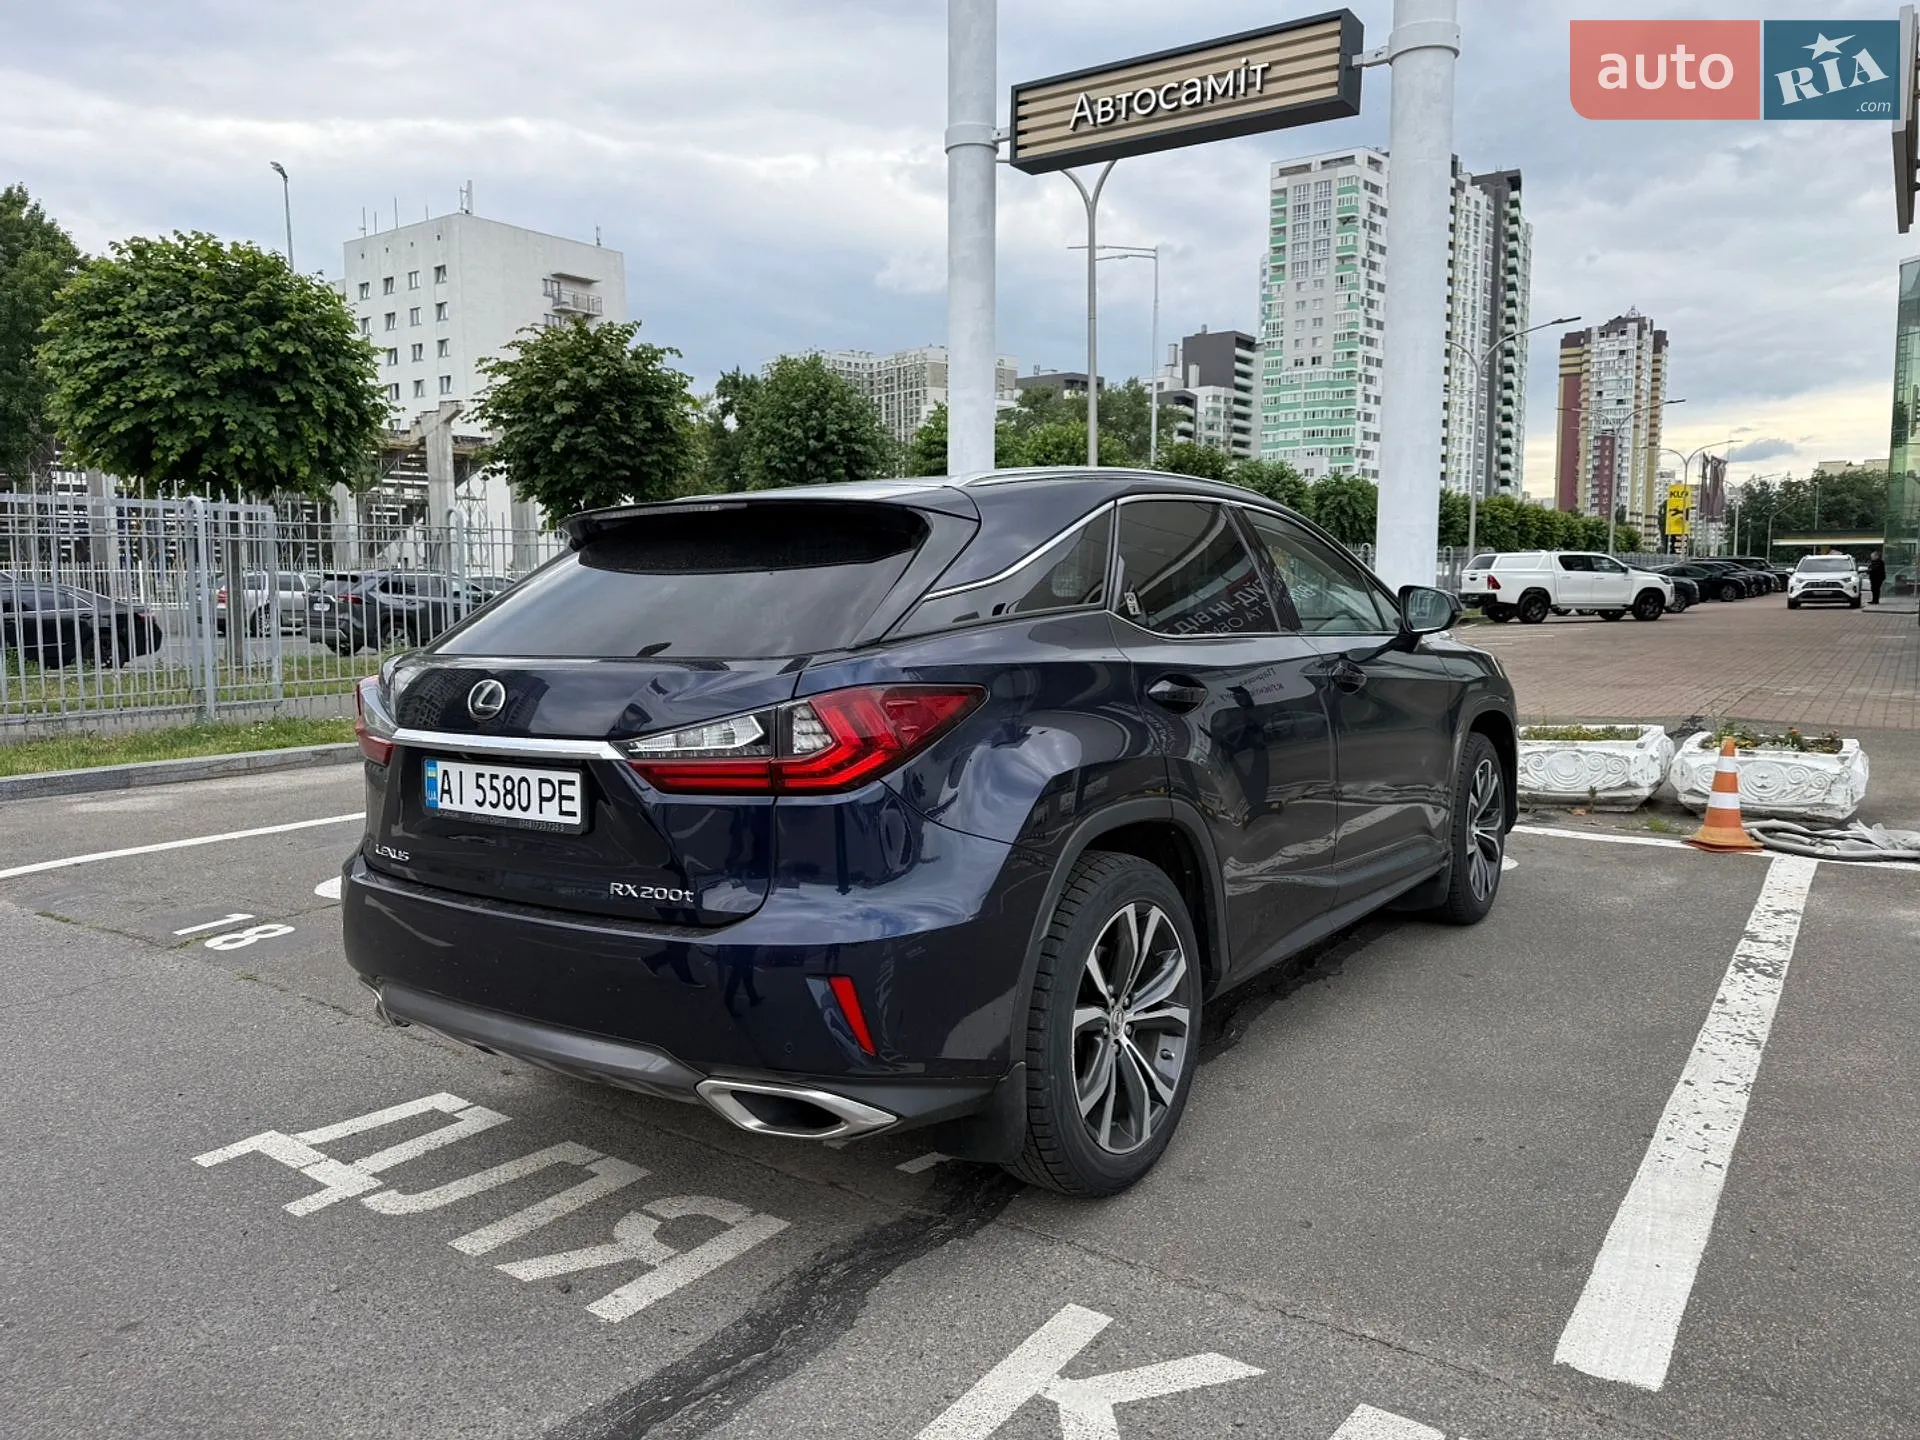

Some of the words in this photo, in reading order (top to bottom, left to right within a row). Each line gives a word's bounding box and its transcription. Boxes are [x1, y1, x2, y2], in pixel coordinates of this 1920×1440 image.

[1069, 57, 1272, 132] Автосаміт
[439, 769, 464, 805] AI
[474, 772, 531, 812] 5580
[537, 777, 578, 817] PE
[375, 843, 410, 861] LEXUS
[191, 1091, 793, 1324] ДЛЯ
